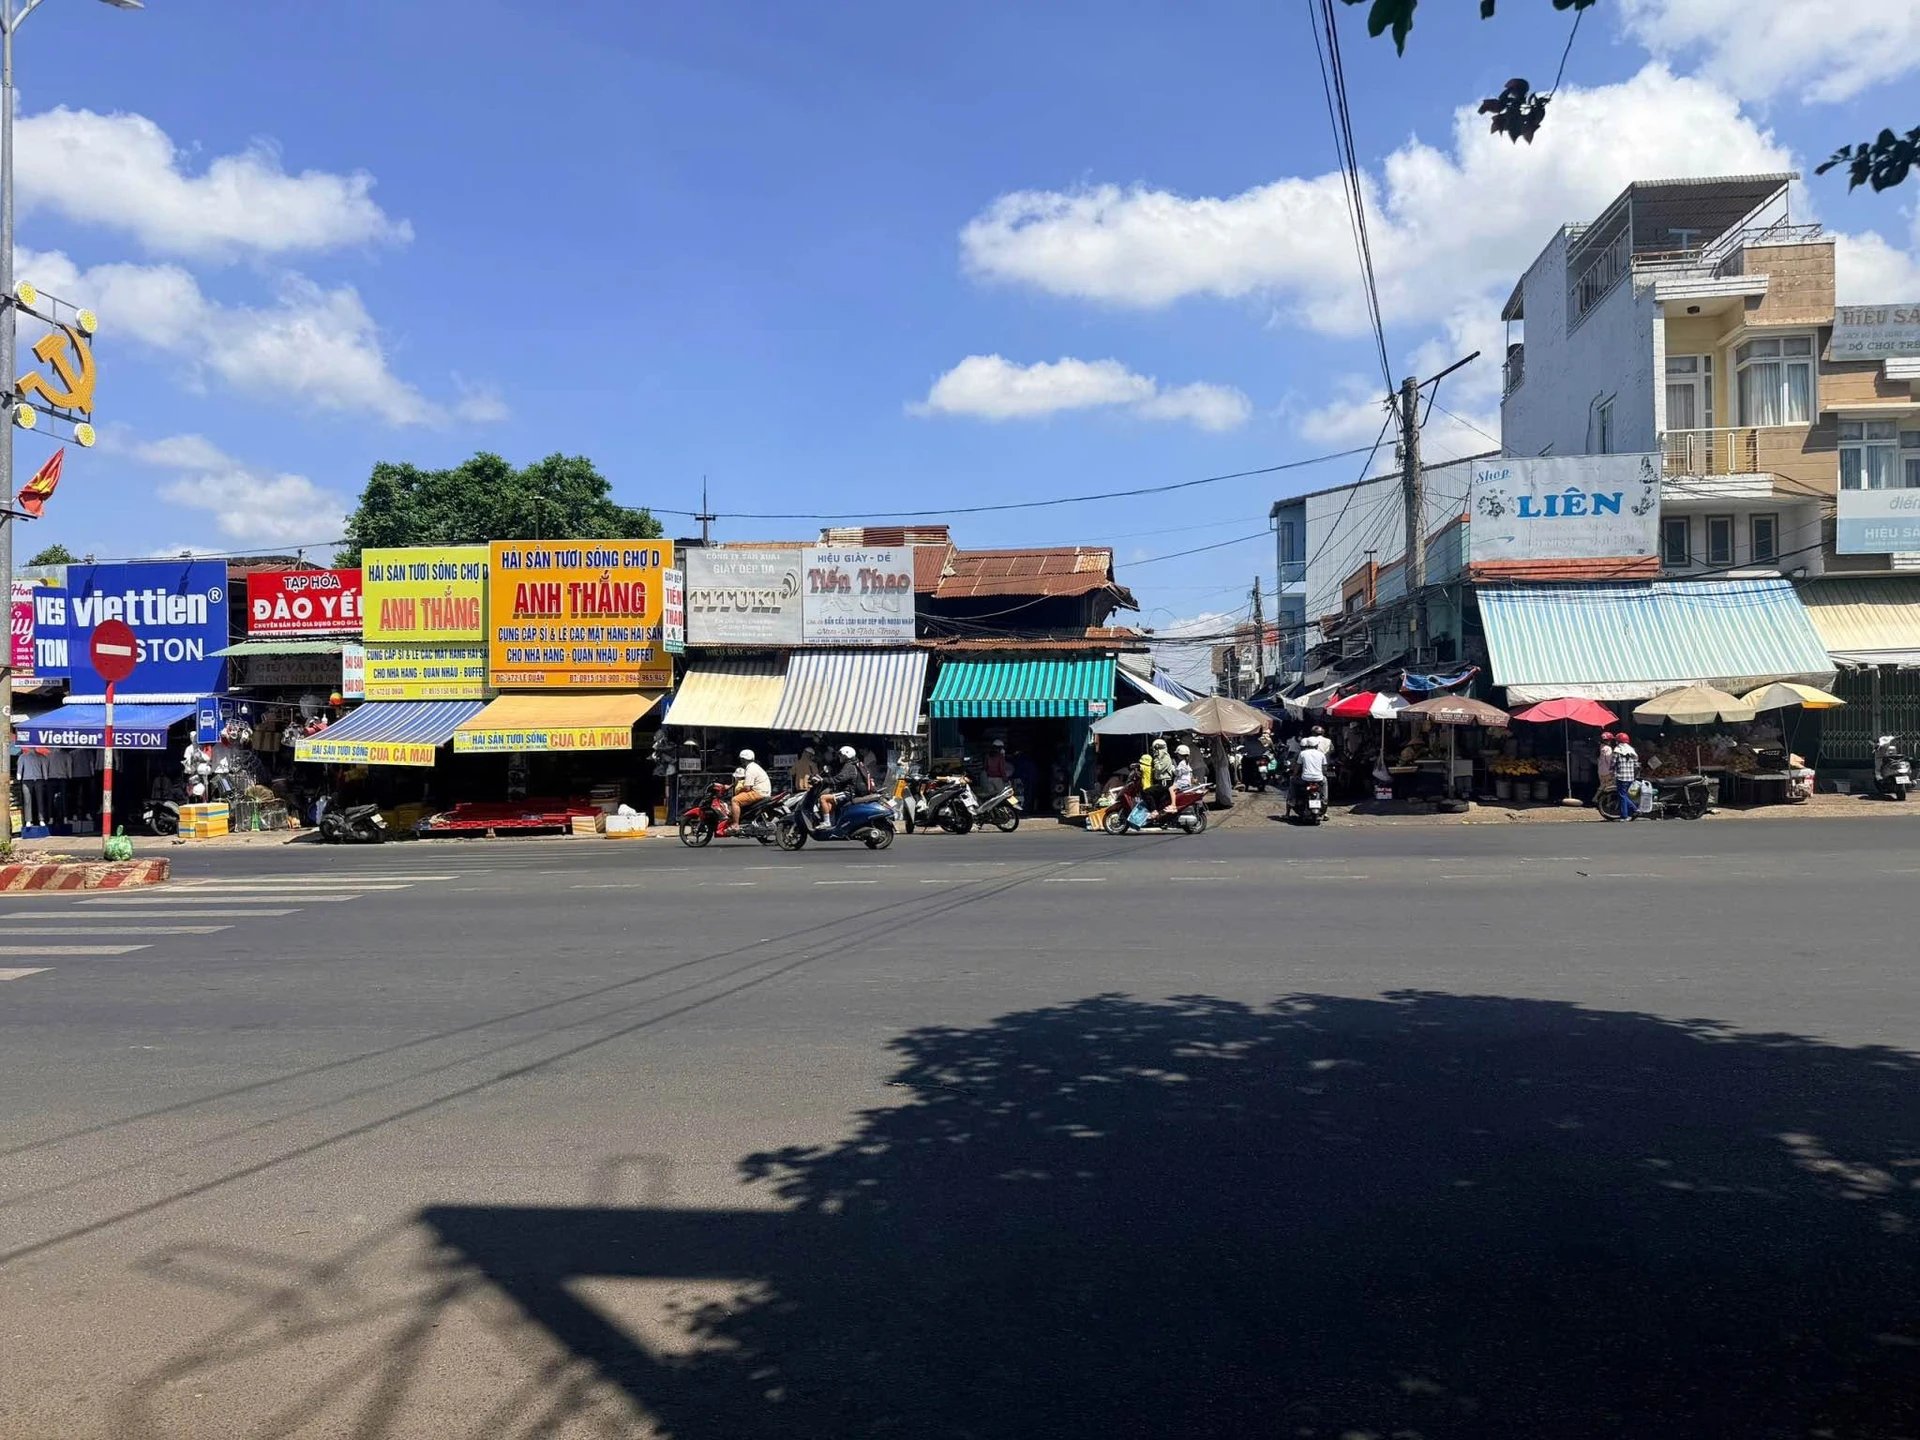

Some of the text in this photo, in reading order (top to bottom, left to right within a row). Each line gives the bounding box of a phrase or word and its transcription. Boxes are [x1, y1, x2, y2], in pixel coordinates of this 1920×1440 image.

[1475, 467, 1510, 484] Shop
[1516, 487, 1624, 518] LIÊN
[502, 546, 521, 568] HẢI
[525, 546, 550, 568] SẢN
[555, 549, 582, 567] TƯƠI
[585, 545, 619, 567] SỐNG
[623, 548, 647, 572] CHỢ
[817, 552, 840, 564] HIỆU
[877, 551, 892, 562] DÉ
[284, 572, 341, 593] TẠP HÓA
[368, 559, 384, 581] HẢI
[387, 559, 405, 581] SẢN
[408, 562, 429, 581] TƯƠI
[432, 557, 457, 580] SỐNG
[460, 562, 479, 584] CHỢ
[513, 570, 647, 617] ANH THẮNG
[36, 597, 66, 625] VES
[253, 593, 313, 620] ĐÀO
[379, 598, 416, 631] ANH
[498, 628, 519, 641] CUNG
[550, 628, 556, 641] &
[36, 639, 69, 667] TON
[136, 638, 204, 662] STON
[507, 649, 522, 662] CHO
[626, 648, 654, 662] BUFFET
[472, 731, 486, 744] HẢI
[488, 731, 504, 744] SẢN
[550, 735, 575, 748] CUA
[600, 732, 630, 747] MAU
[370, 747, 390, 762] CUA
[410, 748, 433, 763] MAU
